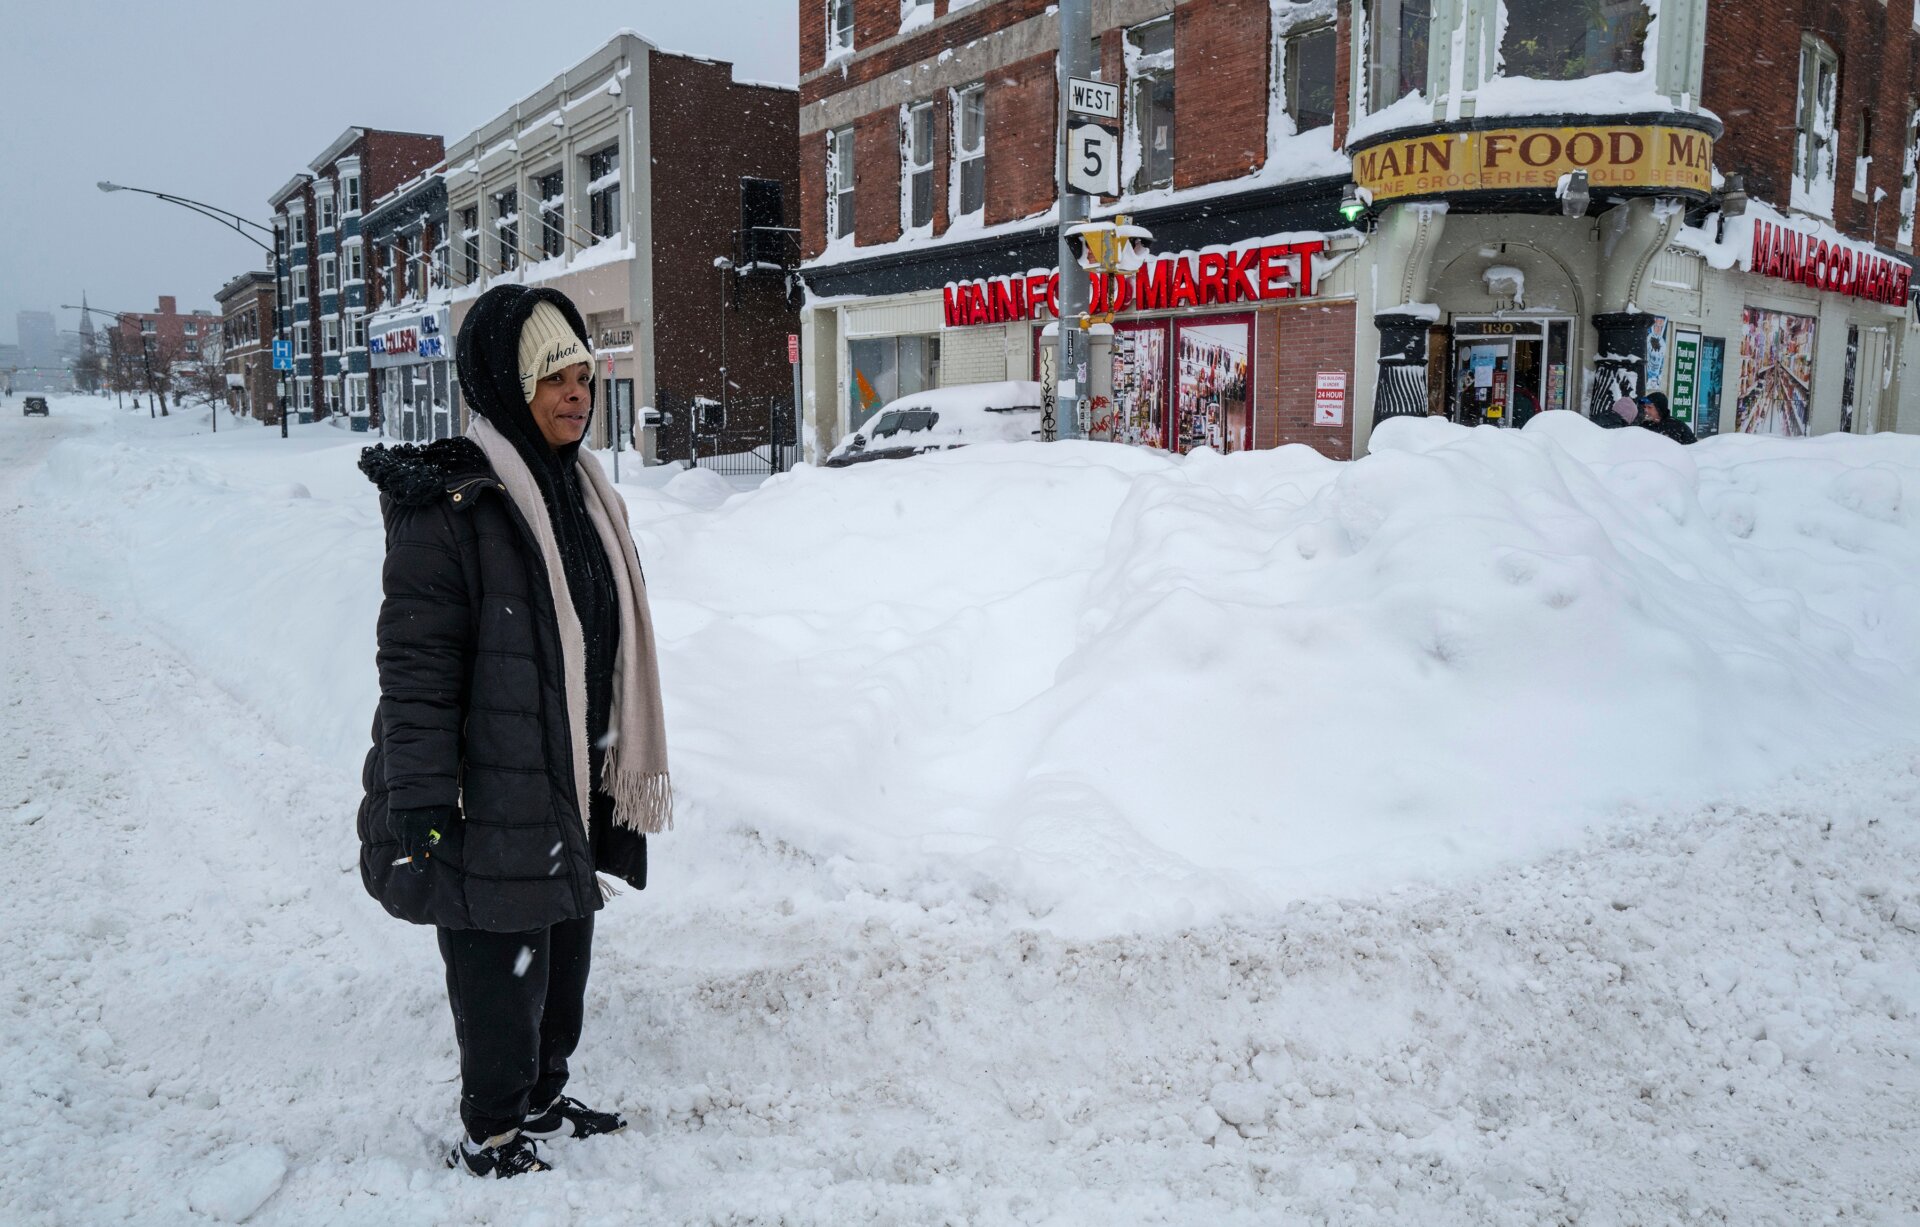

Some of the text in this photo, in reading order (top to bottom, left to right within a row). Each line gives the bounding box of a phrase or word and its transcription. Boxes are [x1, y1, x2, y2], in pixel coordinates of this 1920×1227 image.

[1074, 85, 1112, 111] WEST
[1083, 138, 1102, 177] 5
[1360, 132, 1712, 185] MAIN FOOD MA
[1373, 180, 1405, 201] INE
[1416, 169, 1557, 190] GROCERIES
[1590, 168, 1636, 183] OLD
[1650, 169, 1695, 183] BEER
[1751, 217, 1912, 307] MAIN FOOD MARKET
[943, 276, 1027, 327] MAIN
[1135, 239, 1327, 311] MARKET
[1495, 300, 1527, 311] 1130
[1482, 322, 1514, 334] 1130
[276, 342, 288, 357] H
[546, 342, 578, 372] phat
[1317, 391, 1343, 399] 24 HOUR
